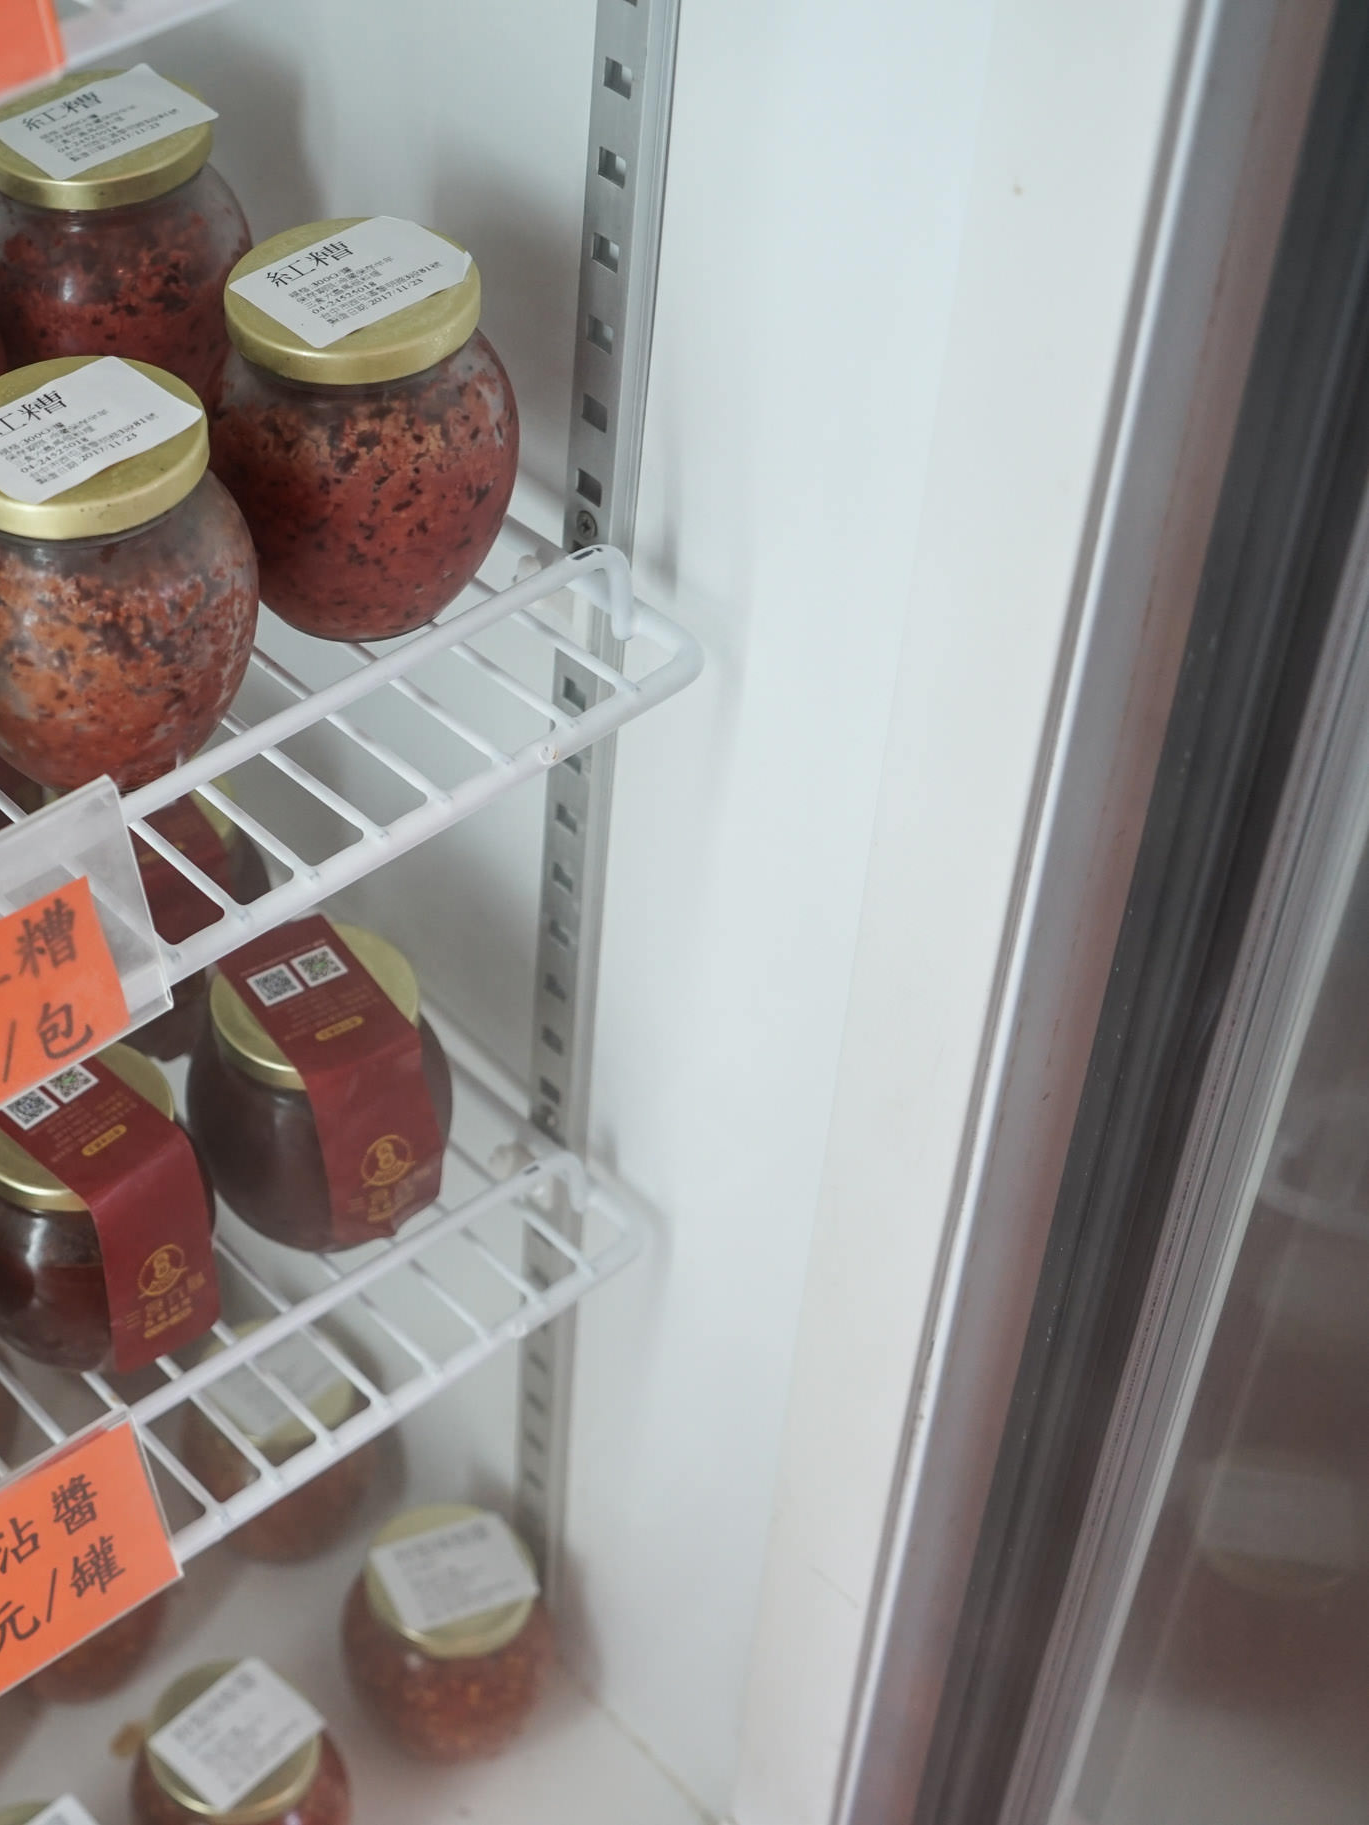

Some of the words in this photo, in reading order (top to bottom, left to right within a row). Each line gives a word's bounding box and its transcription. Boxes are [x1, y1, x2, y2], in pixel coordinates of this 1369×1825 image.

[17, 90, 106, 132] 紅糟
[260, 239, 359, 288] 紅糟
[310, 280, 377, 314] 04-24525018
[18, 436, 90, 473] 04-24525018
